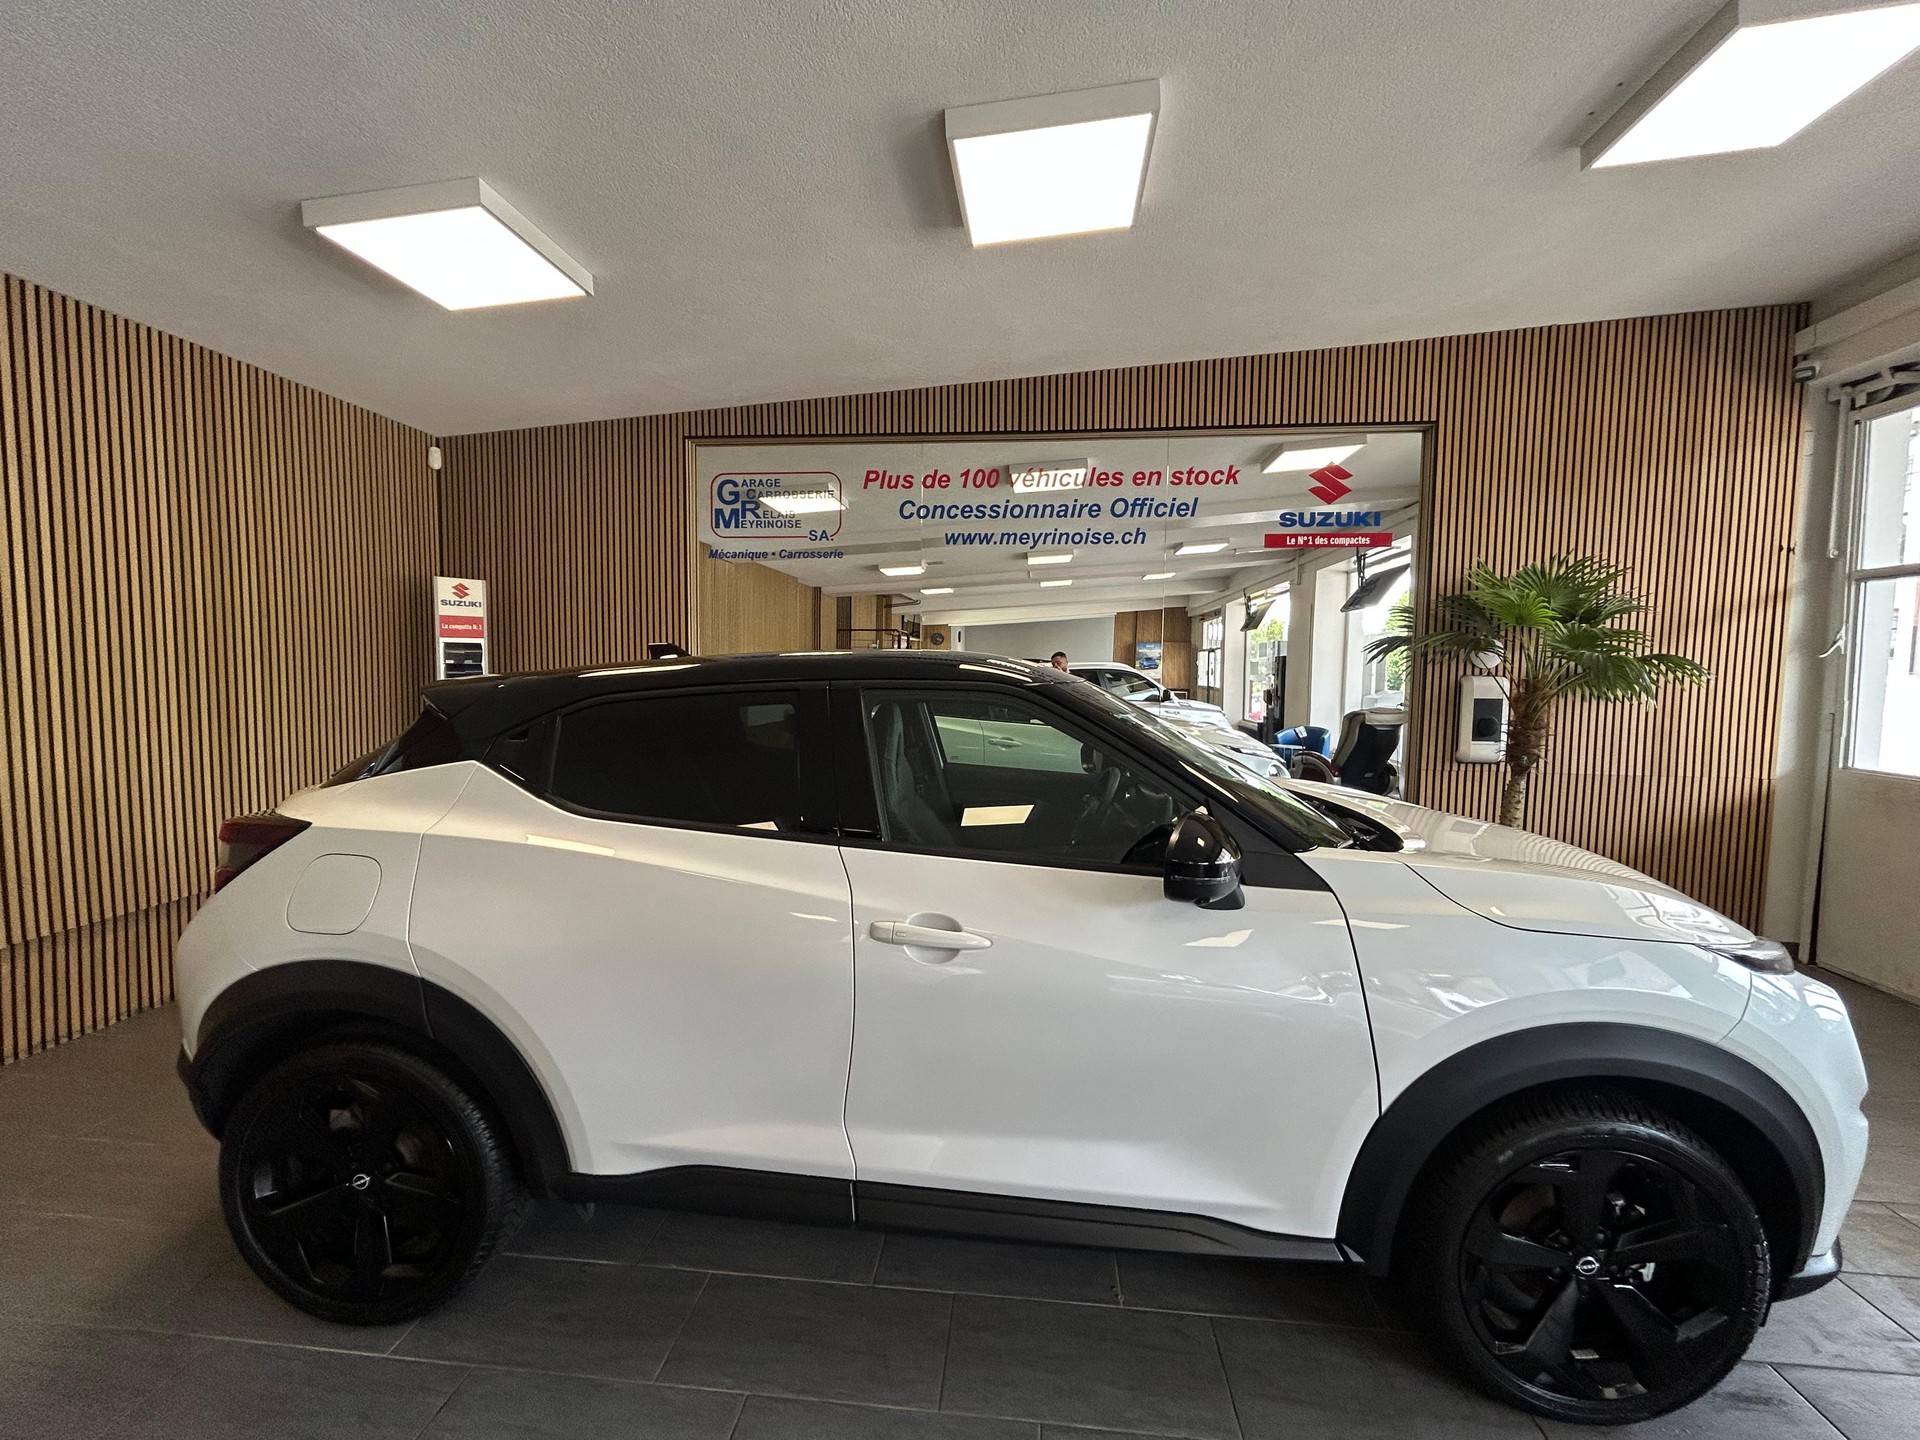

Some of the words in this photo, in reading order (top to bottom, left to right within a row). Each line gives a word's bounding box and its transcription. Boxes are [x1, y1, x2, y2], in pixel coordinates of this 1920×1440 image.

[863, 470, 914, 489] Plus
[922, 469, 950, 488] de
[960, 468, 1000, 489] 100
[1009, 467, 1124, 488] véhicules
[1132, 471, 1162, 487] en
[1170, 465, 1241, 486] stock
[717, 479, 781, 505] GARAGE
[714, 508, 802, 529] MEYRINOISE
[899, 499, 1102, 520] Concessionnaire
[1110, 497, 1199, 518] Officiel
[1279, 511, 1382, 528] SUZUKI
[944, 528, 1147, 549] www.meyrinoise.ch
[1286, 536, 1296, 545] Le
[1315, 536, 1328, 545] des
[1330, 536, 1371, 546] compactes
[708, 548, 768, 560] Mécanique
[779, 549, 844, 559] Carrosserie
[440, 599, 482, 608] SUZUKI
